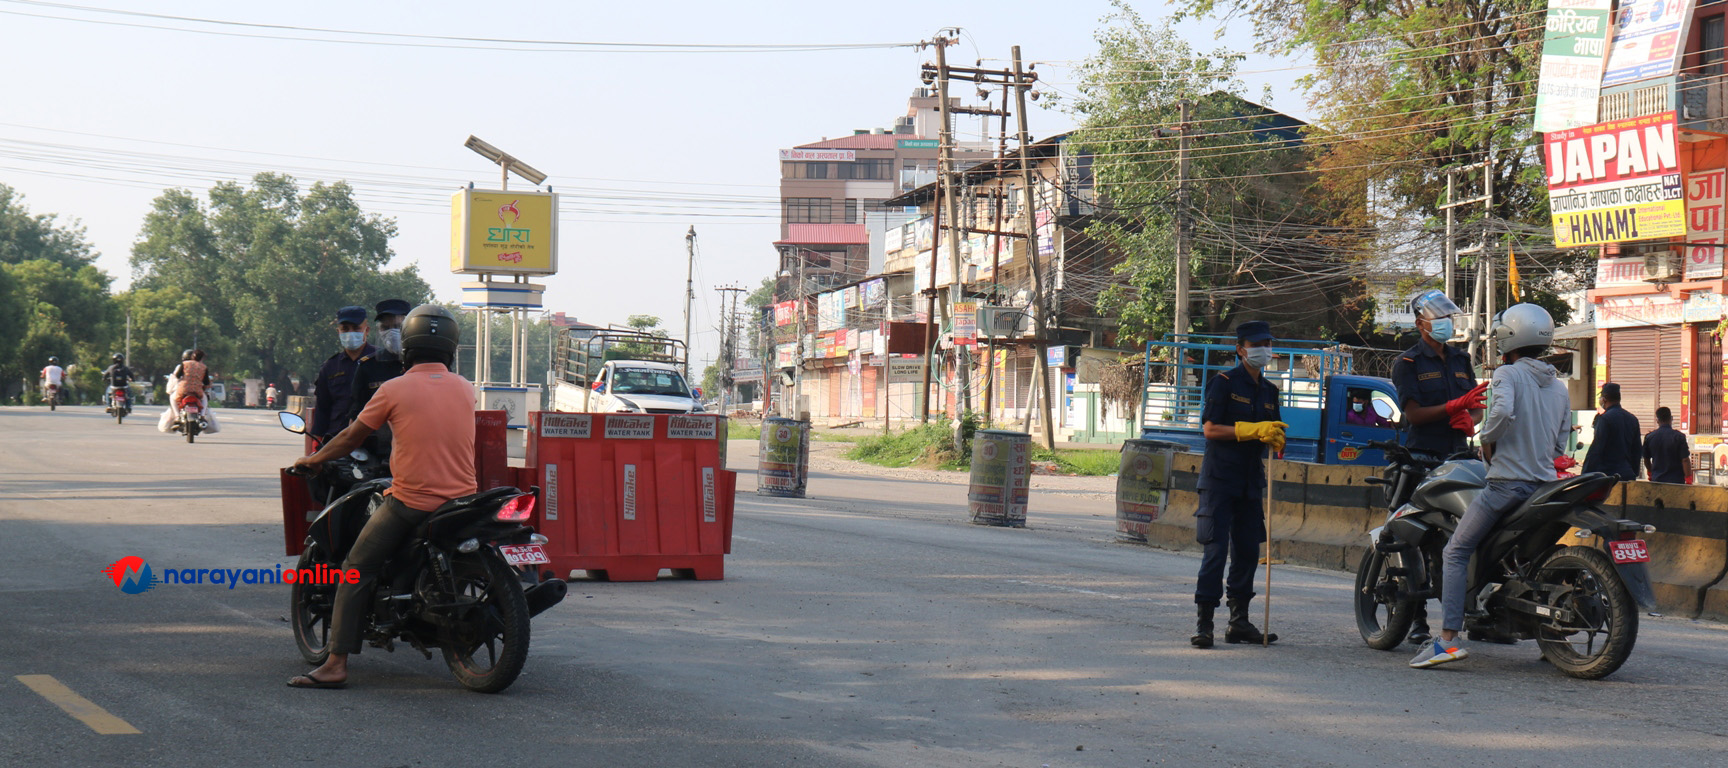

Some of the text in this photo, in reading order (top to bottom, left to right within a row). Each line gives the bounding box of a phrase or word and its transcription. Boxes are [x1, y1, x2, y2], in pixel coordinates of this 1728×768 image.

[1546, 10, 1600, 34] कोरियन
[1574, 37, 1605, 56] भाषा
[1550, 133, 1567, 141] Study
[1550, 123, 1677, 185] JAPAN
[1664, 175, 1680, 186] NAT
[1551, 189, 1588, 212] जापानिज
[1590, 187, 1622, 207] भाषाका
[487, 227, 531, 242] धारा
[1570, 208, 1638, 244] HANAMI
[544, 416, 588, 428] Hilltake
[607, 418, 651, 429] Hilltake
[670, 417, 713, 429] Hilltake
[779, 430, 788, 439] 30
[547, 470, 557, 516] Hilltake
[625, 470, 635, 516] Hilltake
[704, 473, 714, 518] Hilltake
[1140, 493, 1159, 504] SLOW
